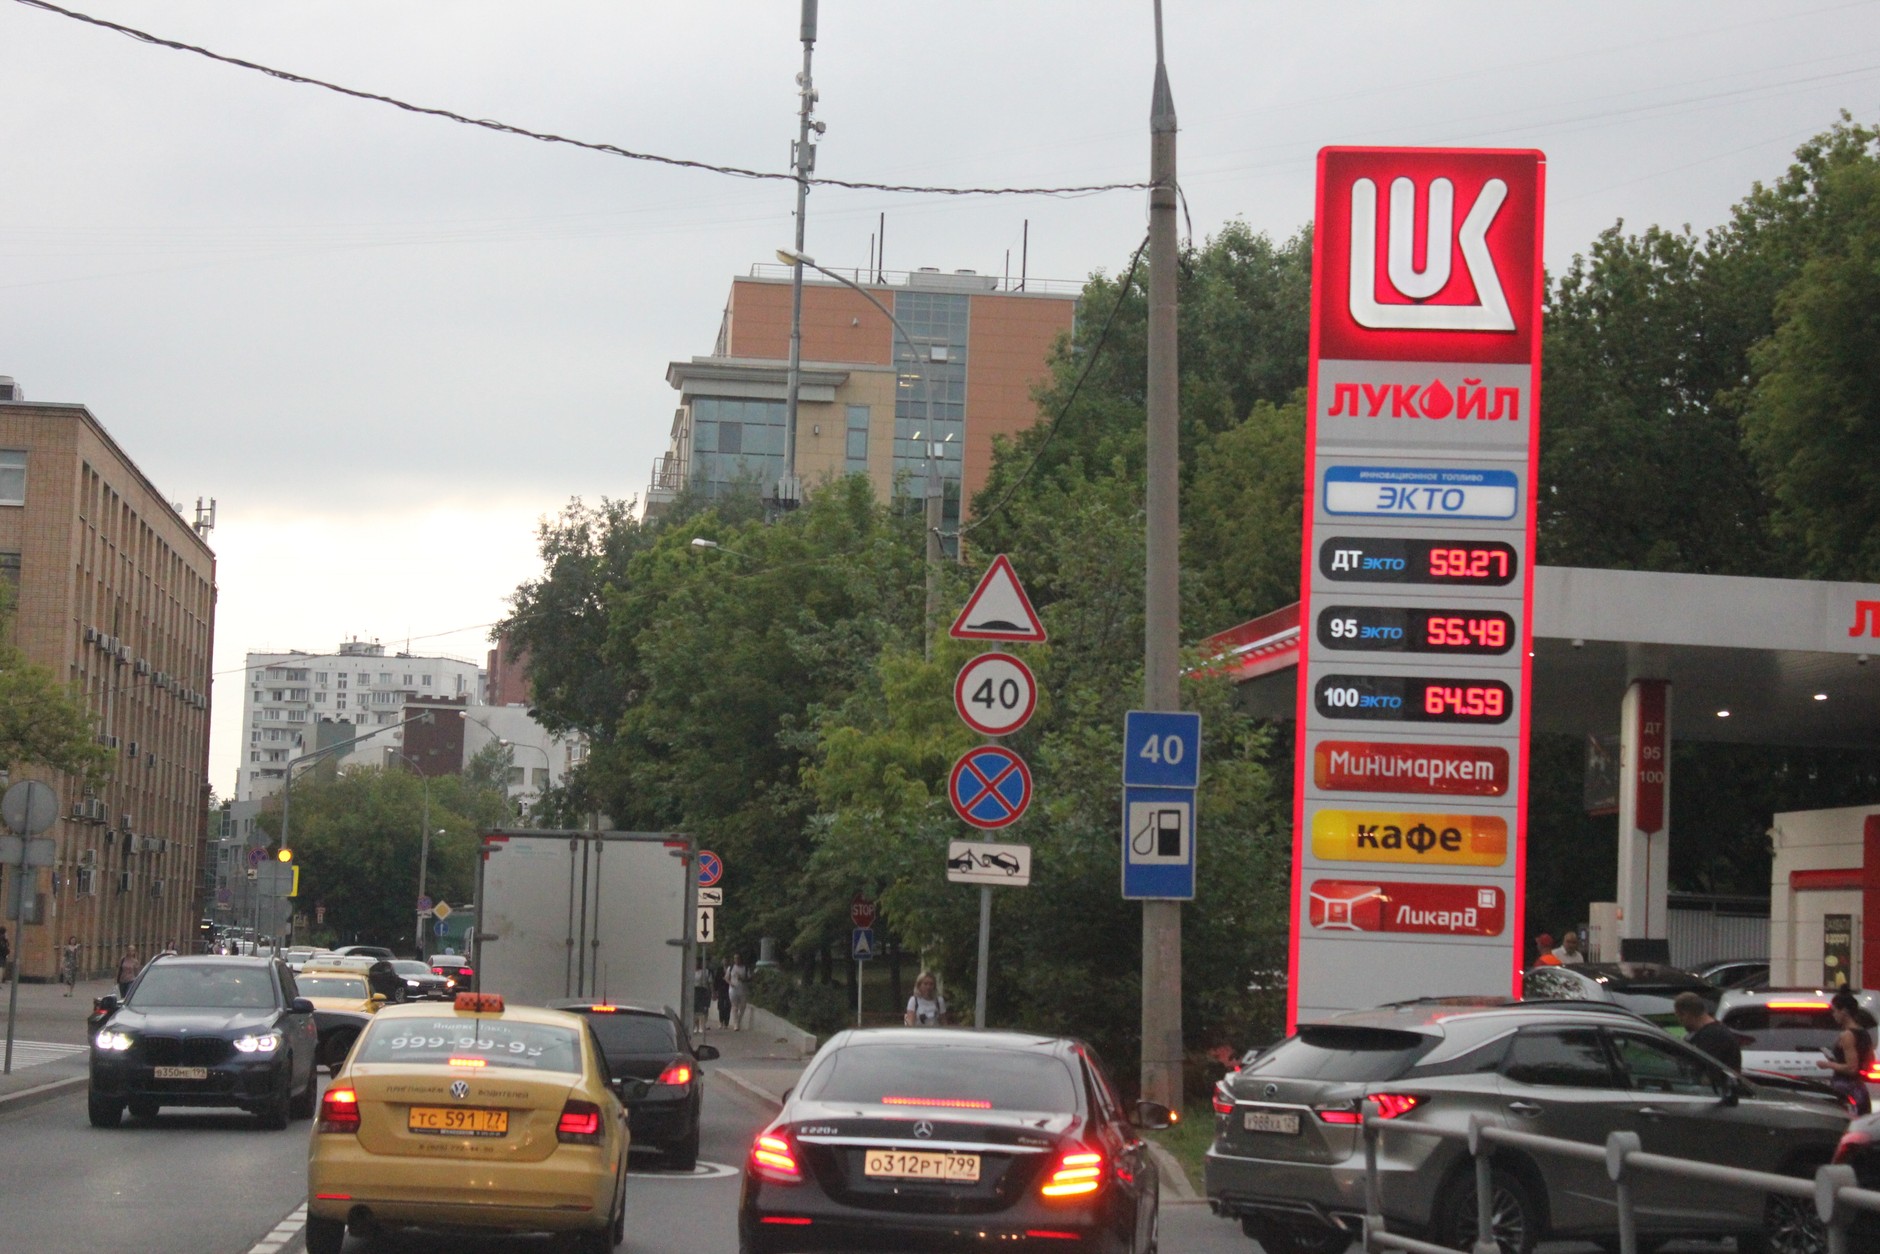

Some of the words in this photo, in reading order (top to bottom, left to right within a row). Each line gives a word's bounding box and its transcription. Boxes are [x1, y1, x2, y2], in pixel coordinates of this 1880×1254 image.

[1328, 378, 1519, 421] ЛУКОЙЛ
[1442, 473, 1483, 482] ТОПЛИВО
[1376, 487, 1465, 511] ЭКТО
[1331, 550, 1363, 571] ДТ
[1362, 557, 1405, 570] ЭКТО
[1429, 548, 1508, 577] 59.27
[1330, 618, 1358, 638] 95
[1360, 626, 1403, 639] ЭКТО
[1427, 617, 1505, 647] 55.49
[972, 678, 1019, 709] 40
[1324, 687, 1359, 707] 100
[1359, 695, 1402, 709] ЭКТО
[1425, 686, 1503, 716] 64.59
[1644, 722, 1662, 735] ДТ
[1139, 735, 1183, 765] 40
[1643, 746, 1661, 760] 95
[1330, 751, 1494, 786] Минимаркет
[1640, 771, 1664, 784] 100
[1357, 822, 1462, 854] кафе
[853, 903, 875, 916] STOP
[1396, 904, 1477, 930] Ликард
[419, 1112, 437, 1126] ТС
[445, 1111, 475, 1128] 591
[486, 1112, 502, 1125] 77
[870, 1154, 943, 1175] О312РТ
[947, 1157, 976, 1173] 799
